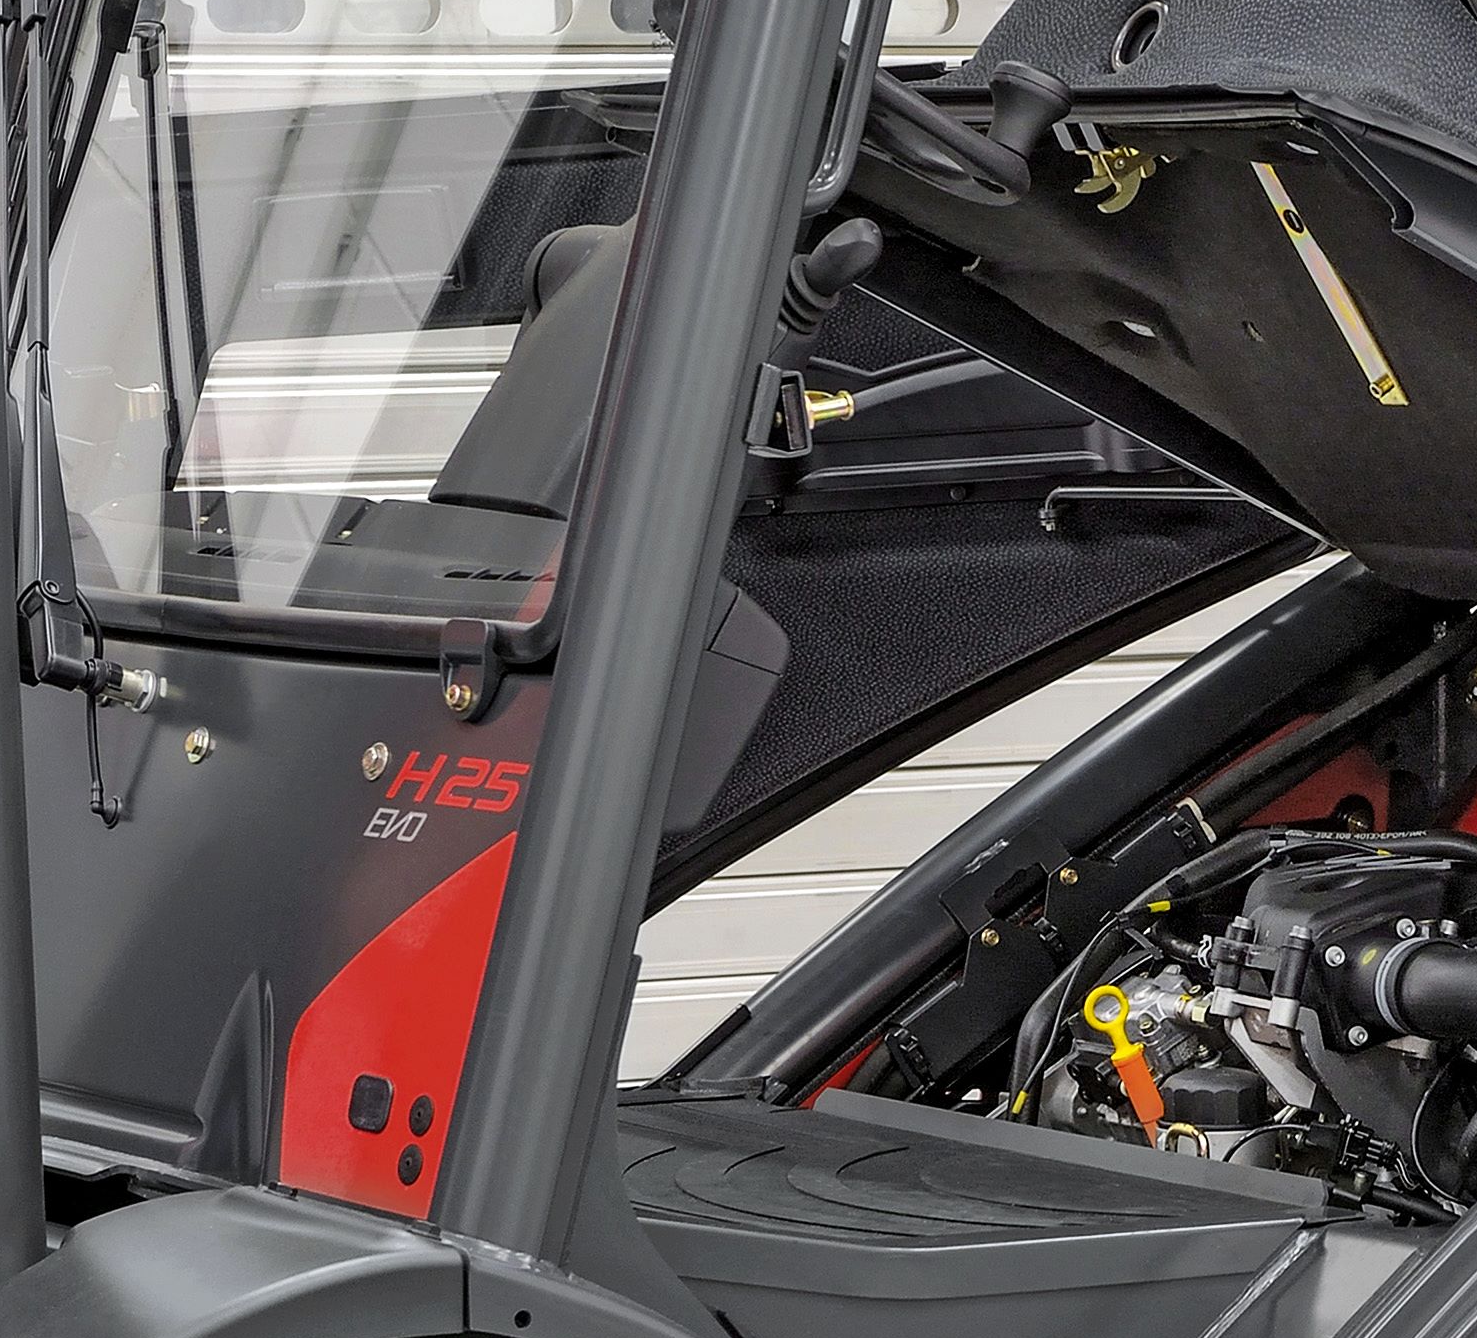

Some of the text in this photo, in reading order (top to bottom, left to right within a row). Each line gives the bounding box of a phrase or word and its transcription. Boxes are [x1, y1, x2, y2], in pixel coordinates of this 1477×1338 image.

[385, 750, 530, 812] H 25
[363, 807, 427, 842] EVO
